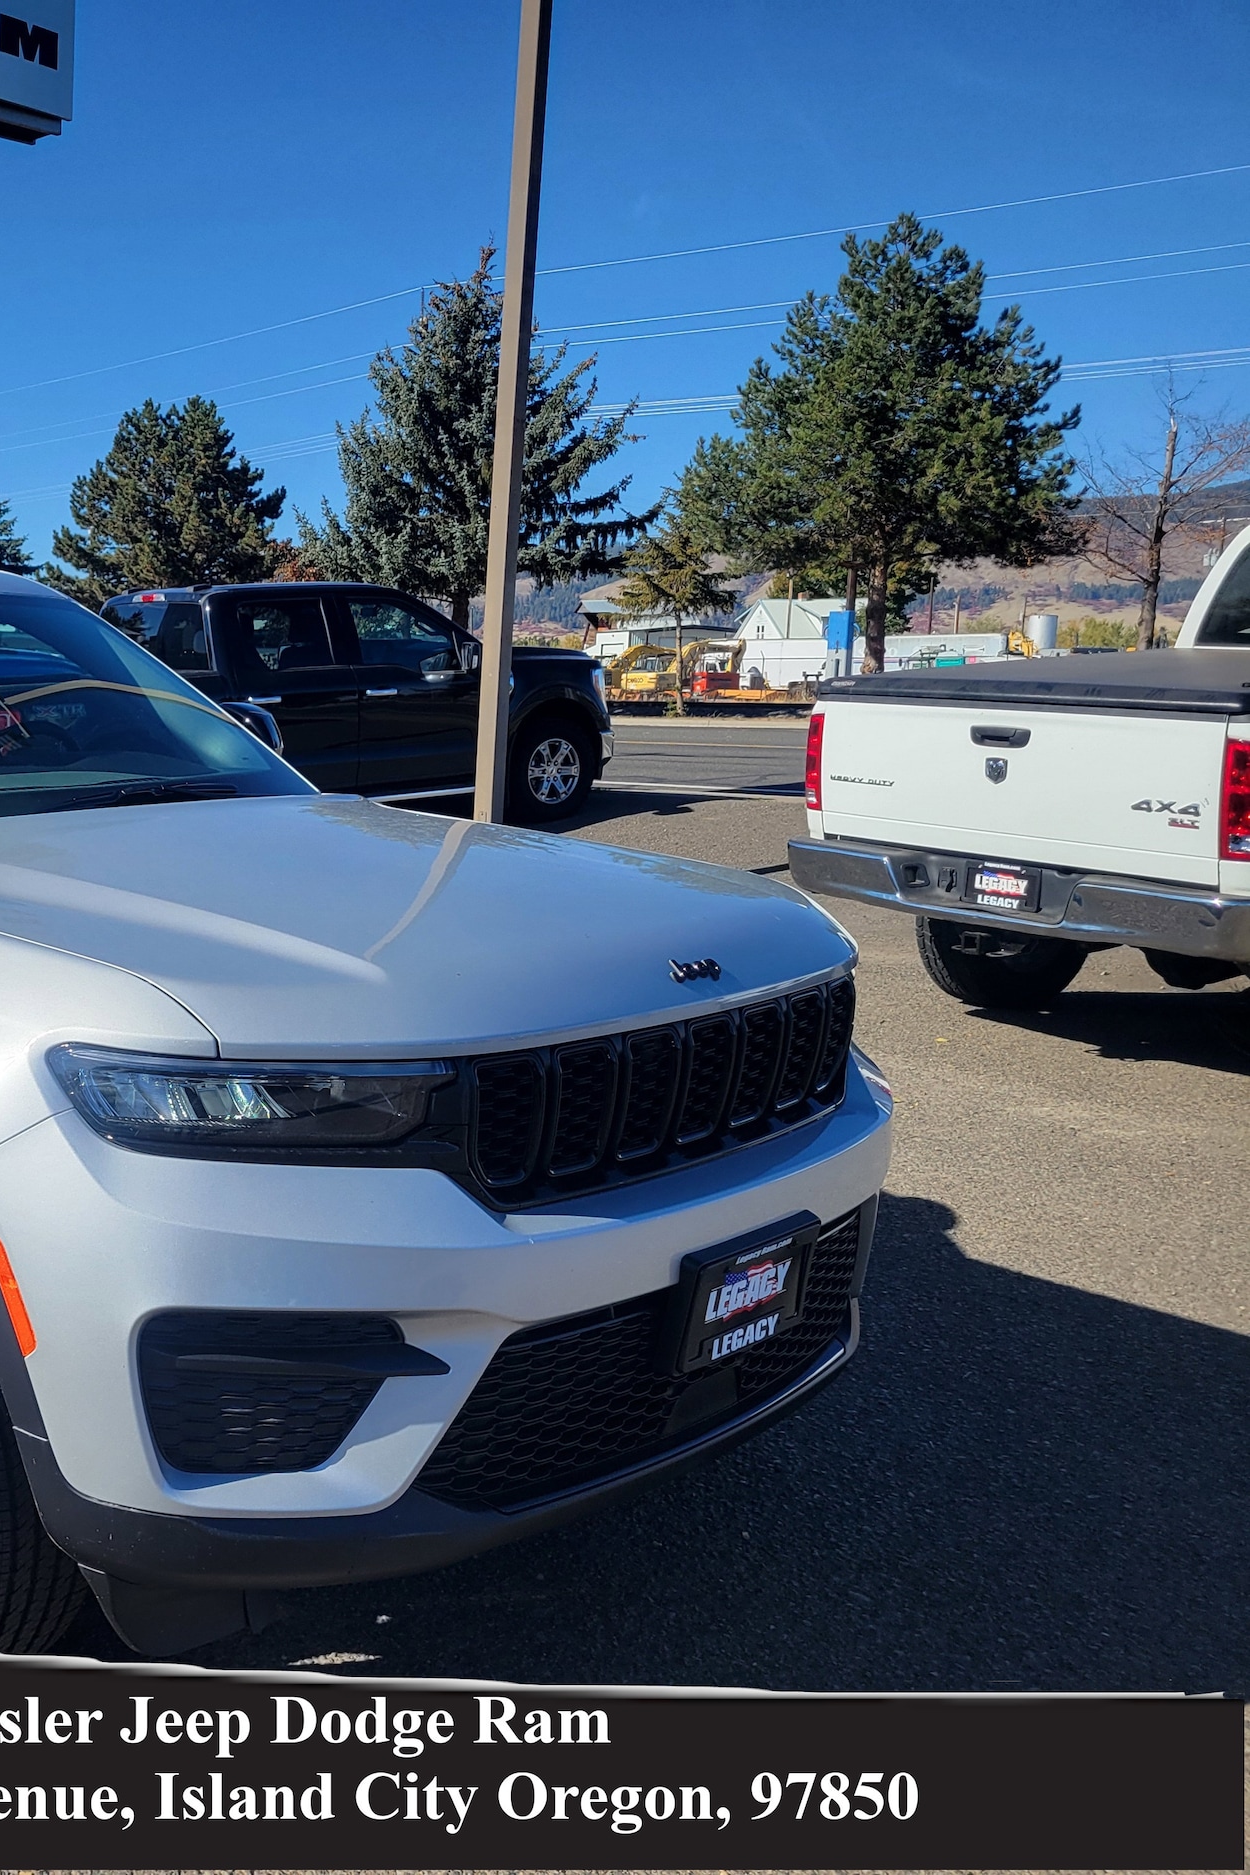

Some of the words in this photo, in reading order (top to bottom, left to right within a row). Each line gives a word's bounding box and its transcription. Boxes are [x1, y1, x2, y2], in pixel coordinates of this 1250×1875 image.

[867, 779, 895, 787] DUTY
[974, 873, 1029, 894] LEGACY
[976, 894, 1020, 909] LEGACY
[704, 1260, 792, 1321] LEGACY
[711, 1312, 780, 1360] LEGACY
